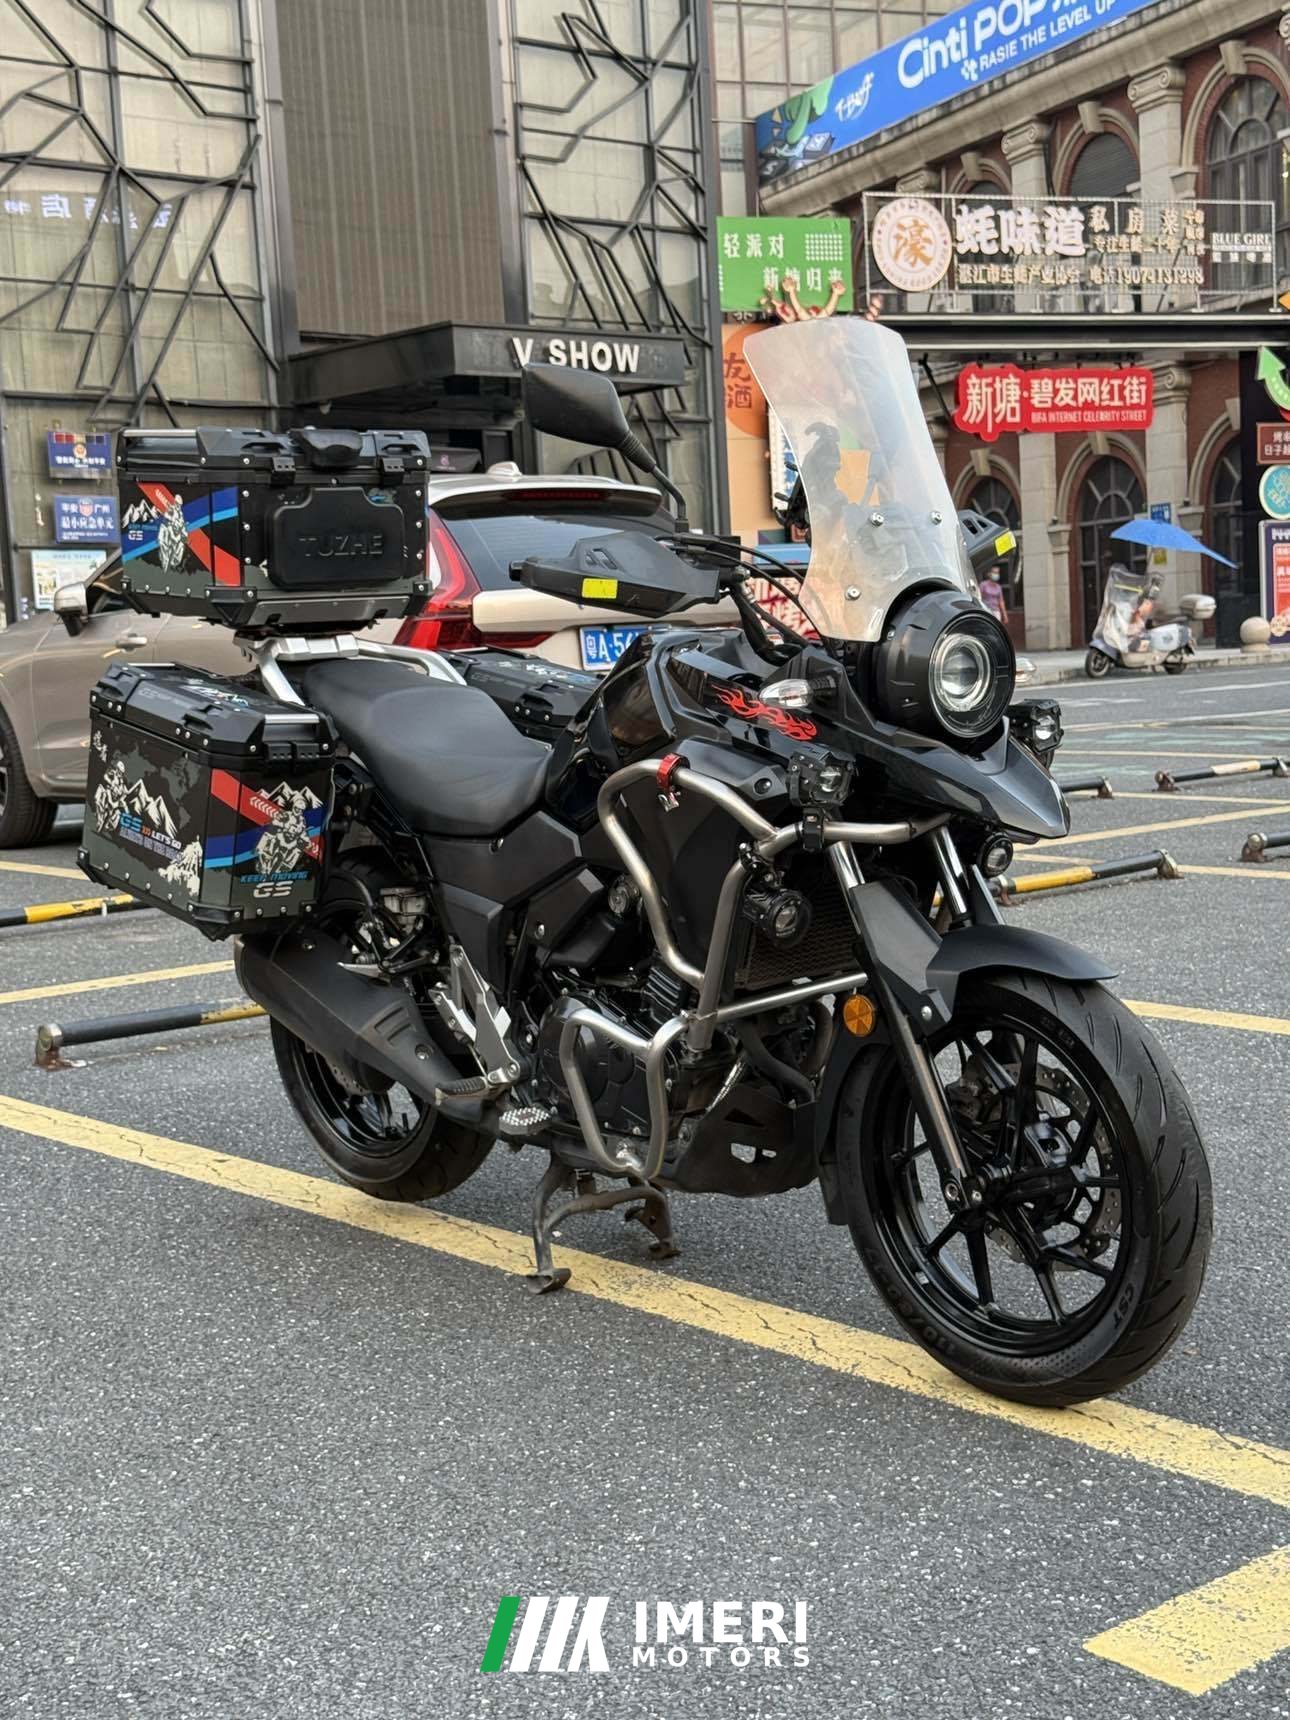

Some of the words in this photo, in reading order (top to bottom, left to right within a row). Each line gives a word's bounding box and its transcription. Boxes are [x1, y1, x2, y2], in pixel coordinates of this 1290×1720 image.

[897, 17, 968, 89] Cinti
[973, 0, 1045, 51] POP
[979, 43, 1018, 72] RASIE
[1020, 29, 1047, 49] THE
[1050, 8, 1092, 37] LEVEL
[724, 233, 785, 259] 轻派对
[1212, 232, 1240, 245] BLUE
[1243, 233, 1272, 246] GIRL
[511, 336, 534, 368] V
[548, 338, 640, 373] SHOW
[1048, 411, 1082, 424] INTERNET
[1121, 409, 1147, 422] STREET
[128, 530, 144, 541] GS
[151, 830, 171, 845] LET'S
[253, 880, 294, 898] GS
